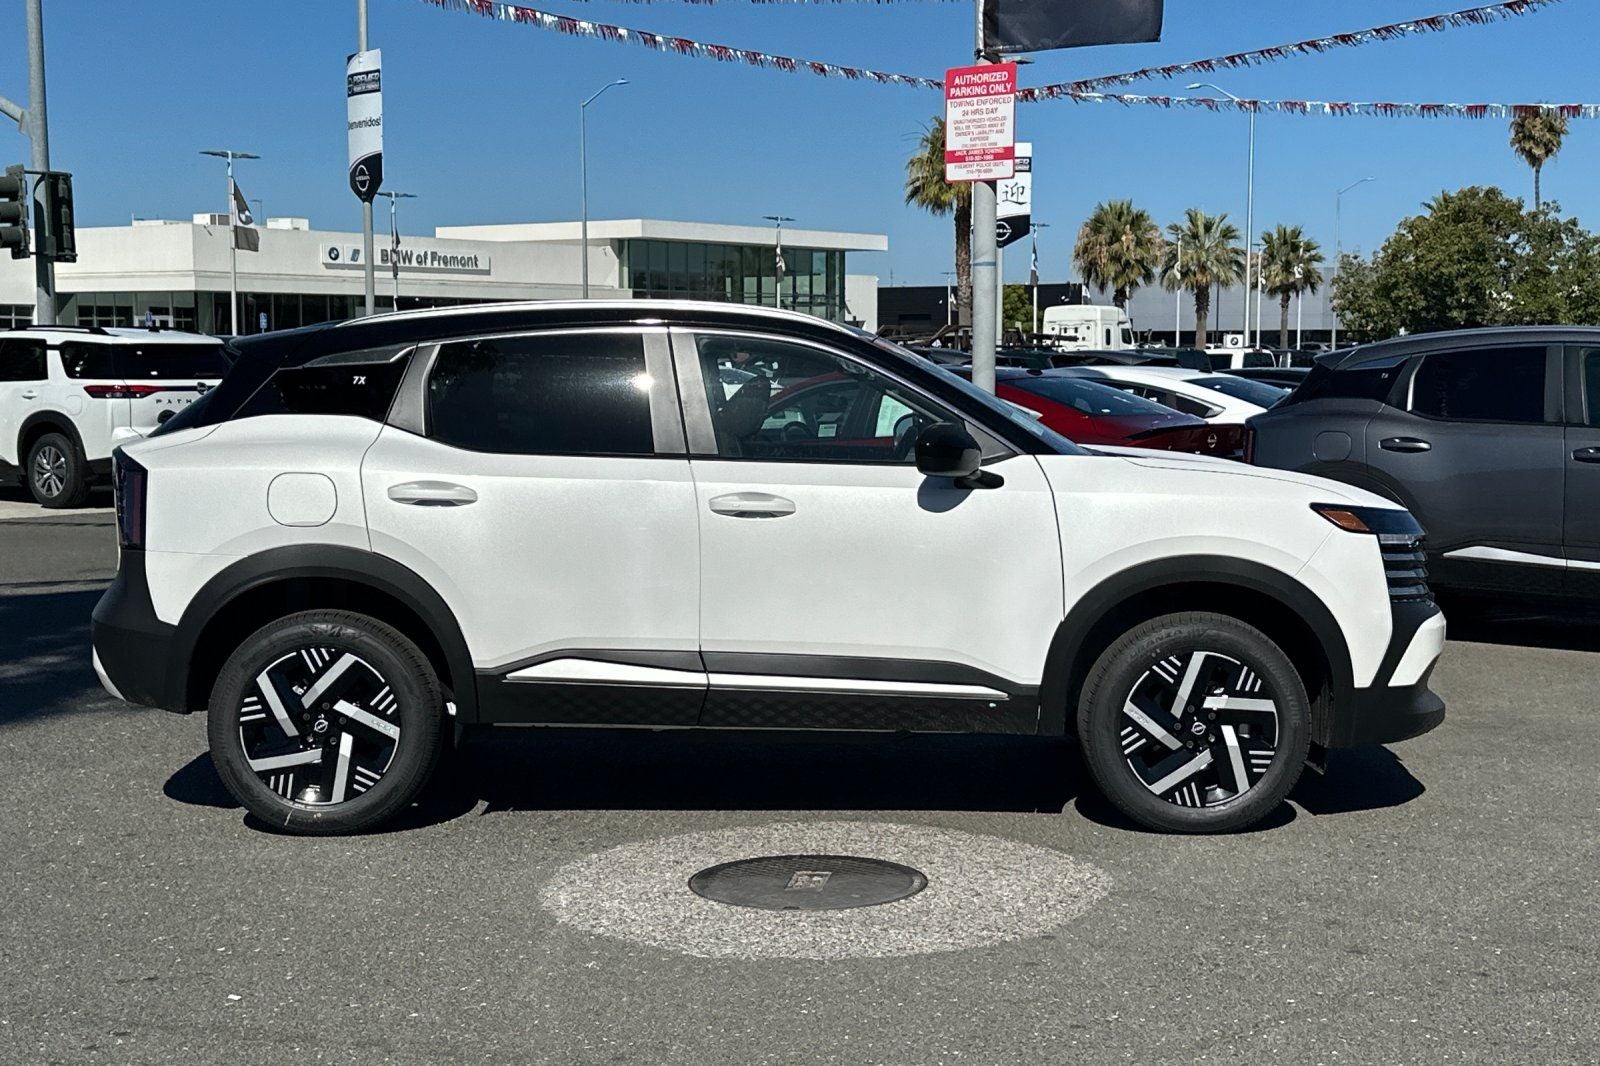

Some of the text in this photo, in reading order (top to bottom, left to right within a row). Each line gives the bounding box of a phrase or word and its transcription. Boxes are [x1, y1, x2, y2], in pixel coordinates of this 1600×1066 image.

[954, 71, 1009, 86] AUTHORIZED
[950, 82, 1012, 98] PARKING ONLY
[950, 96, 1012, 109] TOWING ENFORCED
[962, 107, 998, 117] 24 HRS DAY
[1001, 182, 1027, 205] 迎
[415, 250, 428, 266] of
[431, 251, 479, 268] Fremont
